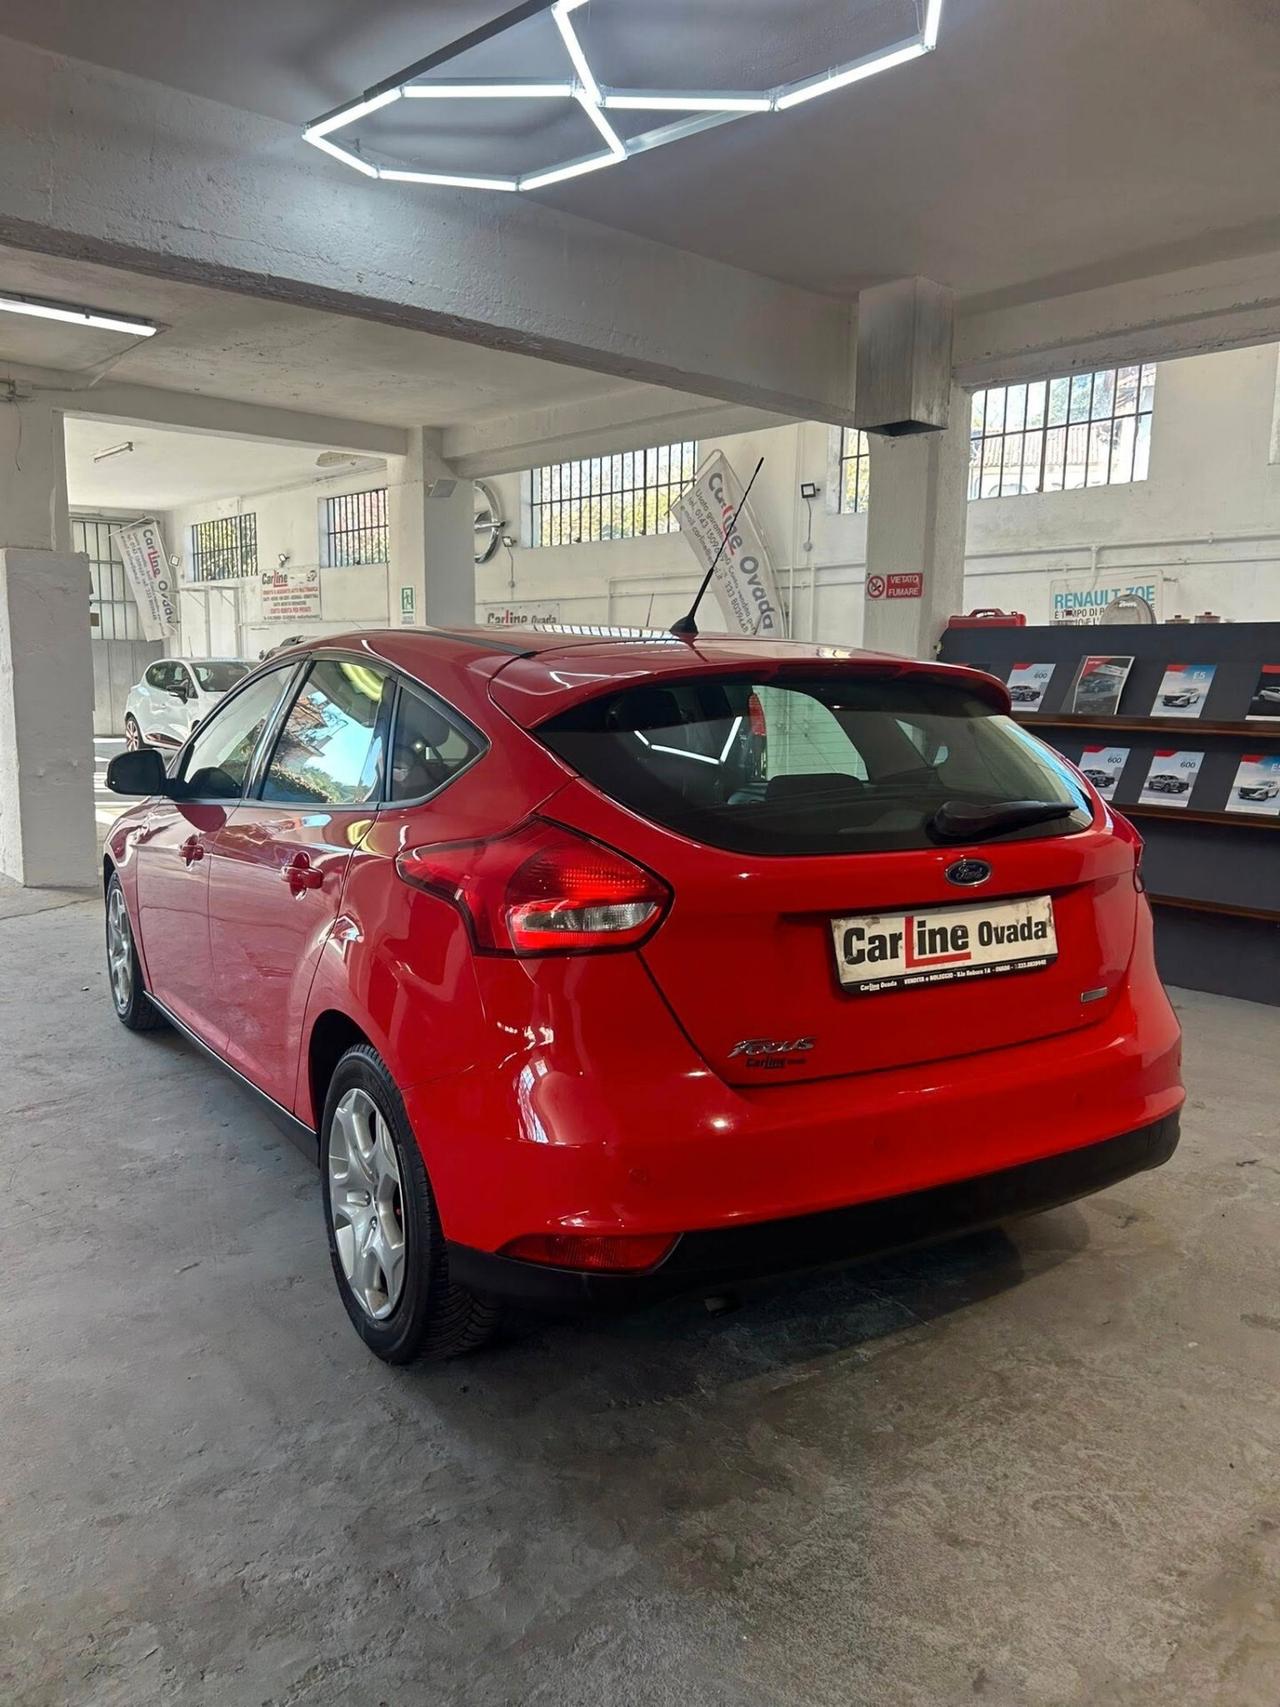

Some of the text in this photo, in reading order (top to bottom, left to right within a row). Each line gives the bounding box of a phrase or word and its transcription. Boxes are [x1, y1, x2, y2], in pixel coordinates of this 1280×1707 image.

[695, 509, 708, 527] 0143
[890, 575, 919, 583] VIETATO
[740, 555, 775, 629] Ovada
[888, 587, 920, 597] FUMARE
[1054, 588, 1121, 609] RENAULT
[1061, 608, 1087, 619] TMPO
[1180, 761, 1196, 769] 600
[978, 916, 1047, 946] Ovada
